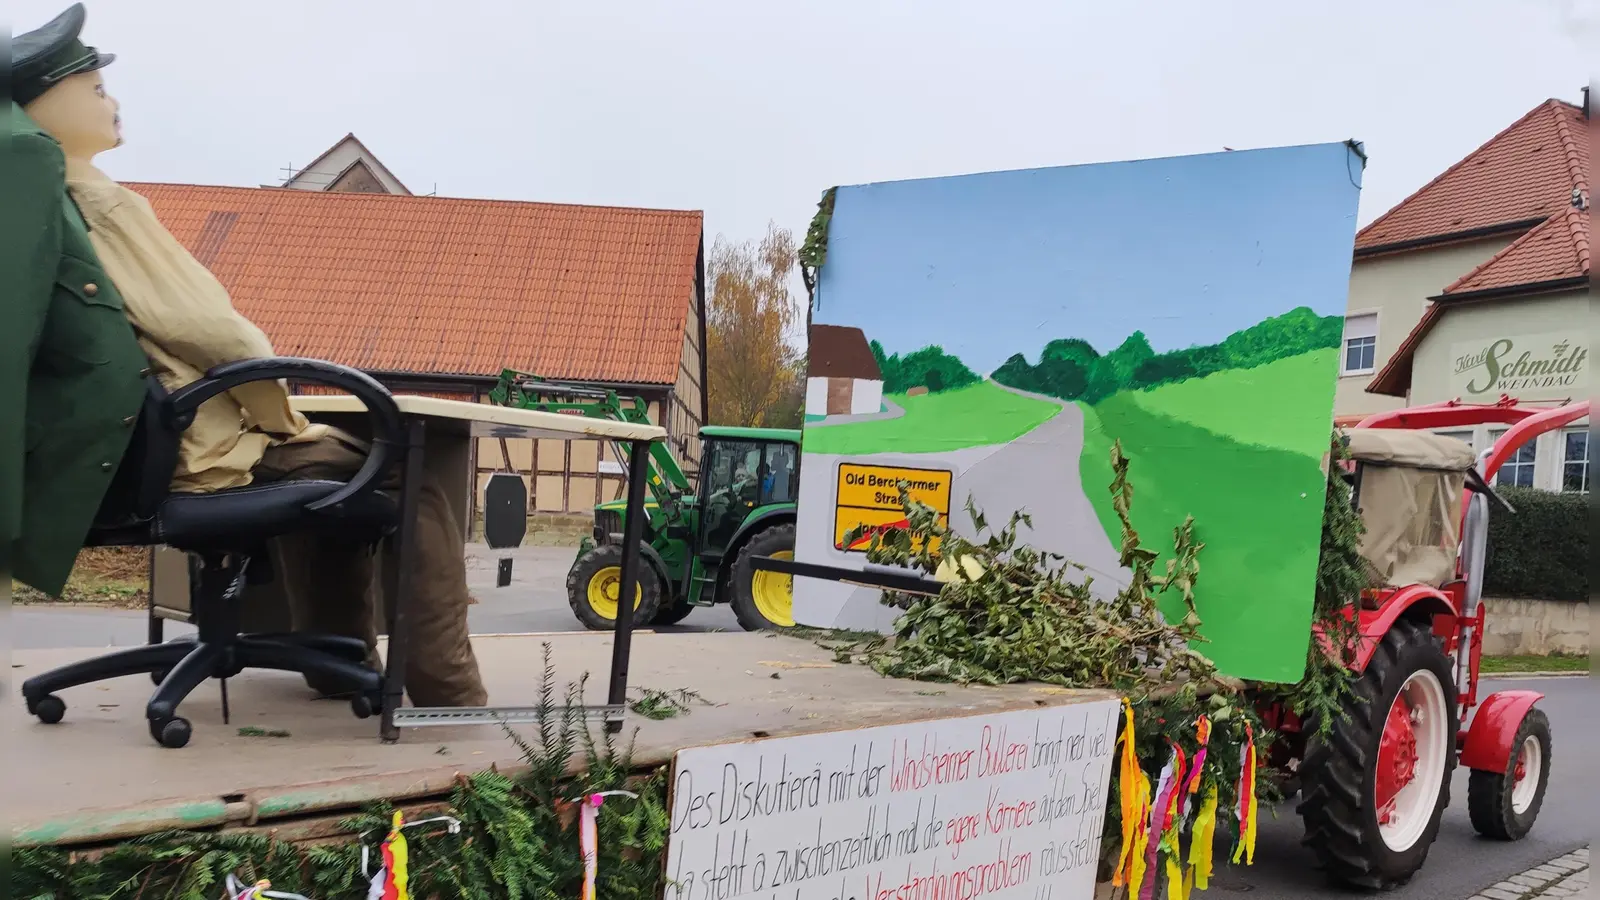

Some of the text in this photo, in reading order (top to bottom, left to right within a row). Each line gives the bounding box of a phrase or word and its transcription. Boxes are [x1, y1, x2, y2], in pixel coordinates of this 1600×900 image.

[1454, 339, 1588, 394] Karl Schmidt
[1498, 374, 1578, 390] WEINBAU
[845, 473, 865, 485] Old
[673, 769, 716, 833] Des
[719, 753, 822, 825] Diskutierä
[828, 744, 856, 804] mit
[858, 741, 886, 798] der
[891, 732, 975, 792] Windsheimer
[978, 725, 1030, 778] Bullerei
[1032, 716, 1064, 778] bringt
[1064, 712, 1088, 762] ned
[701, 828, 748, 900] steht
[772, 803, 891, 887] zwischenzeitlich
[923, 794, 942, 848] die
[945, 812, 980, 860] eigene
[984, 784, 1036, 836] Karriere
